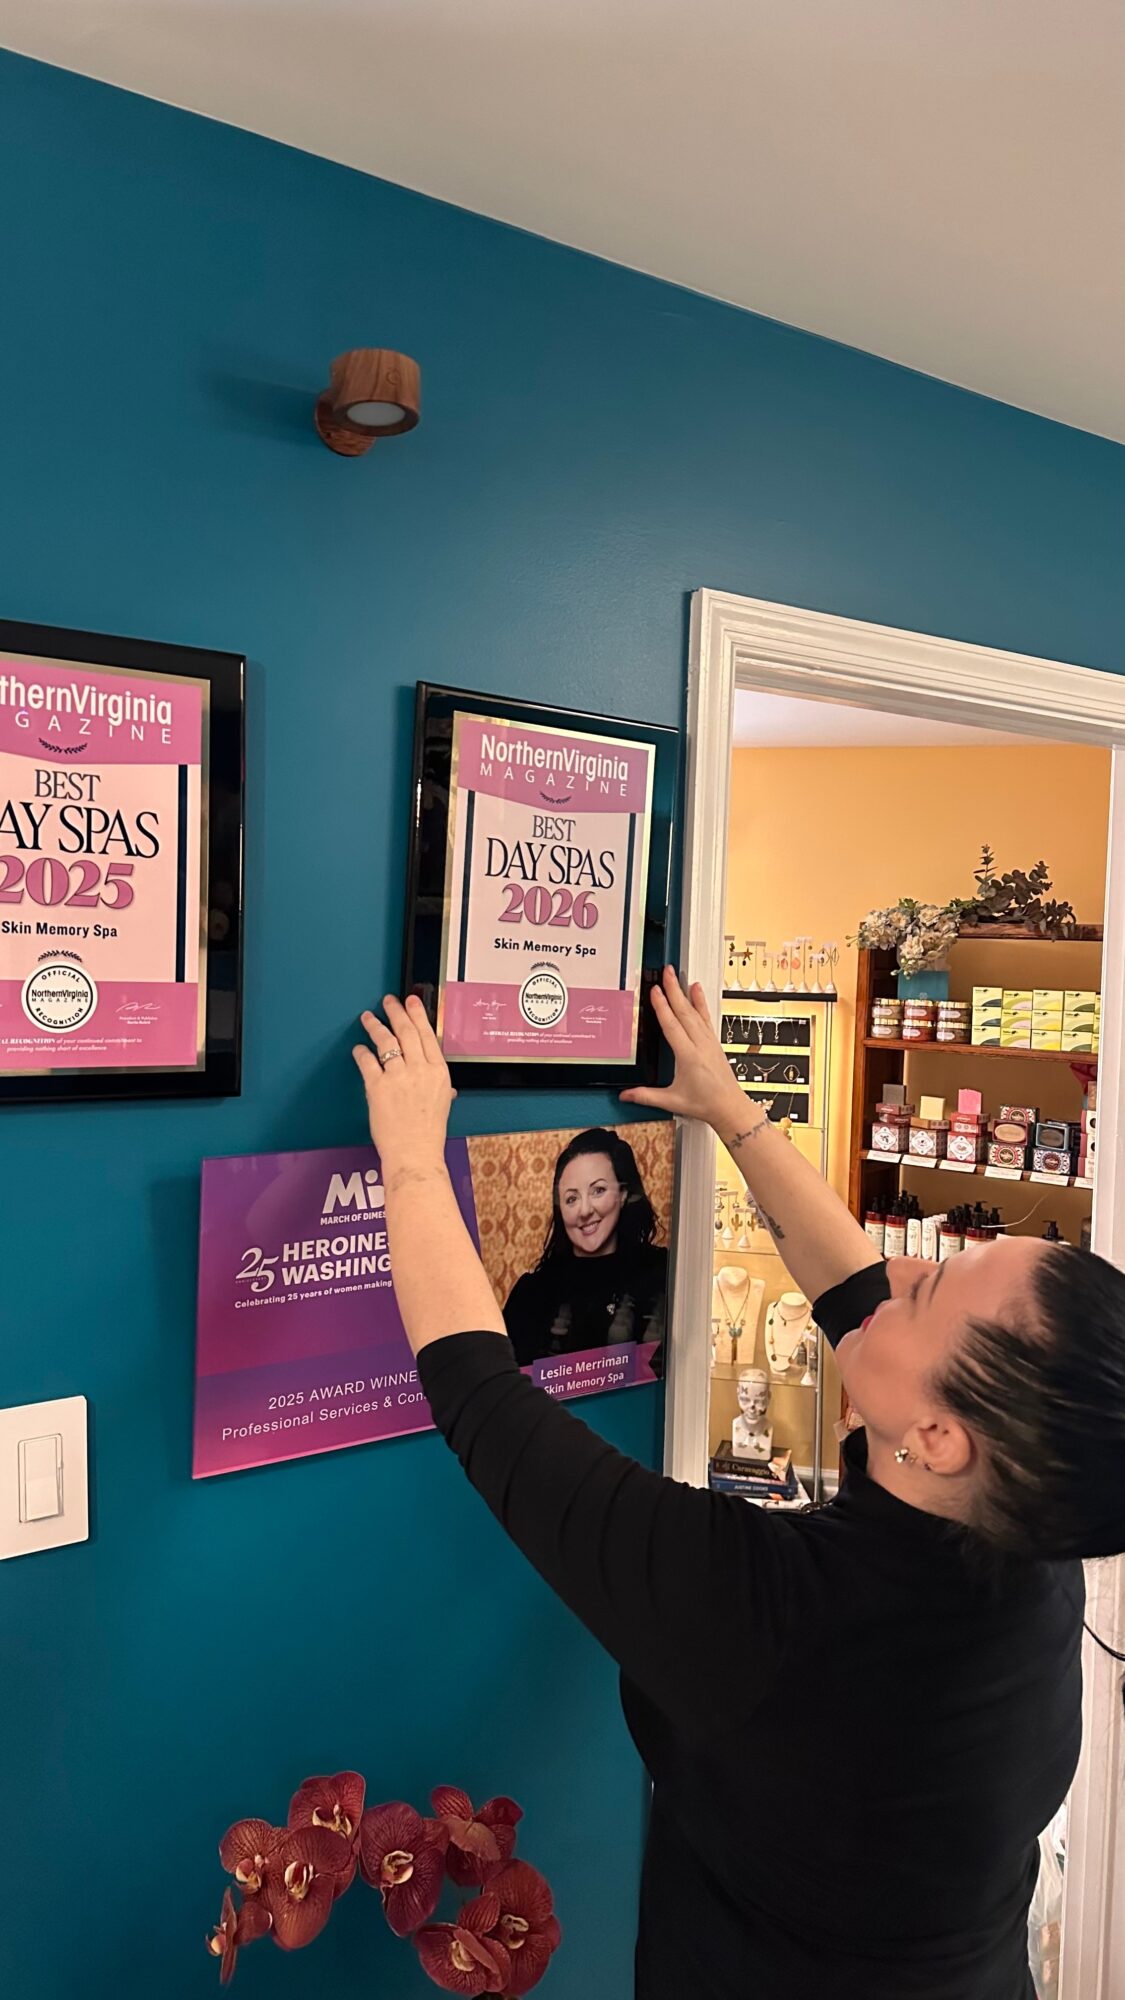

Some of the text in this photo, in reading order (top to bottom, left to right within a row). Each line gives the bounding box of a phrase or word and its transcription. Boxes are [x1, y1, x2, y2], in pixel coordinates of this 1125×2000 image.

[481, 733, 629, 782] NorthernVirginia
[34, 768, 101, 802] BEST
[479, 762, 628, 797] MAGAZINE
[58, 804, 160, 858] SPAS
[532, 815, 576, 842] BEST
[485, 837, 615, 889] DAY SPAS
[0, 854, 135, 910] 2025
[498, 883, 599, 930] 2026
[1, 920, 118, 939] Skin Memory Spa
[494, 938, 597, 958] Skin Memory Spa
[41, 970, 81, 983] OFFICIAL
[31, 989, 89, 1000] NorthernVirginia
[35, 1007, 84, 1025] RECOGNITION
[320, 1216, 350, 1226] MARCH
[351, 1213, 362, 1222] OF
[283, 1231, 390, 1263] HEROINE
[235, 1247, 279, 1293] 25
[282, 1253, 392, 1286] WASHING
[234, 1279, 393, 1309] Celebrating 25 years of women making
[540, 1355, 629, 1380] Leslie Merriman
[543, 1372, 624, 1395] Skin Memory Spa
[268, 1370, 418, 1410] 2025 AWARD WINNE
[222, 1391, 427, 1441] Professional Services & Con
